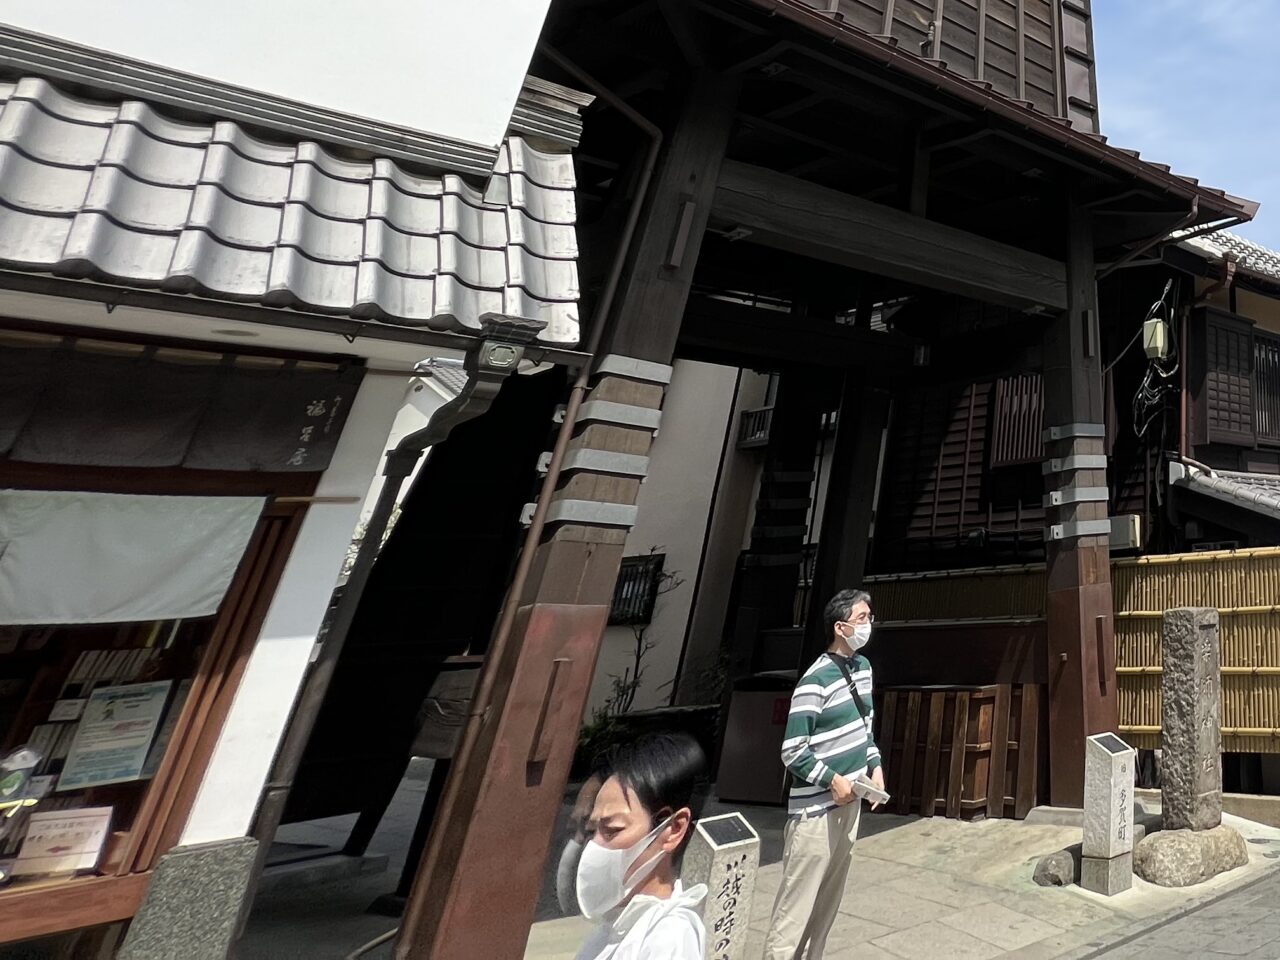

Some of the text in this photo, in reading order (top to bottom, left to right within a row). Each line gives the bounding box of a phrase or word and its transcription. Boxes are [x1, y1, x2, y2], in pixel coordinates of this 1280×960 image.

[714, 853, 747, 960] 川越の時の
